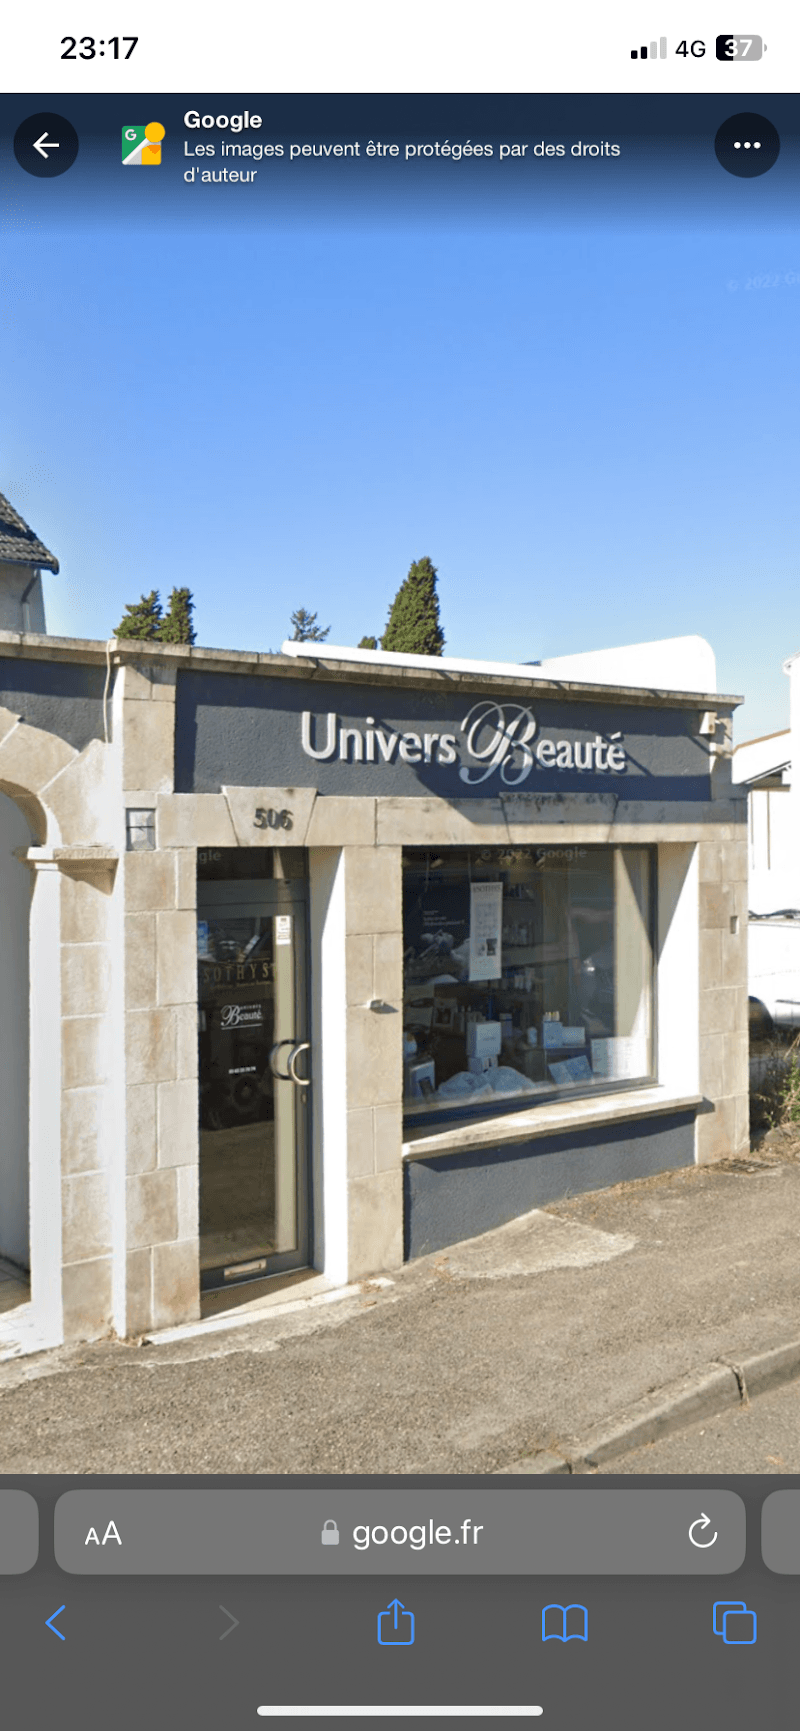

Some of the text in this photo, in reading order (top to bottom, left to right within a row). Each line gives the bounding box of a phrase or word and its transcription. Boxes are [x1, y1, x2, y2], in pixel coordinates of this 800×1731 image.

[302, 701, 627, 786] Univers Beauté
[253, 808, 294, 831] 506
